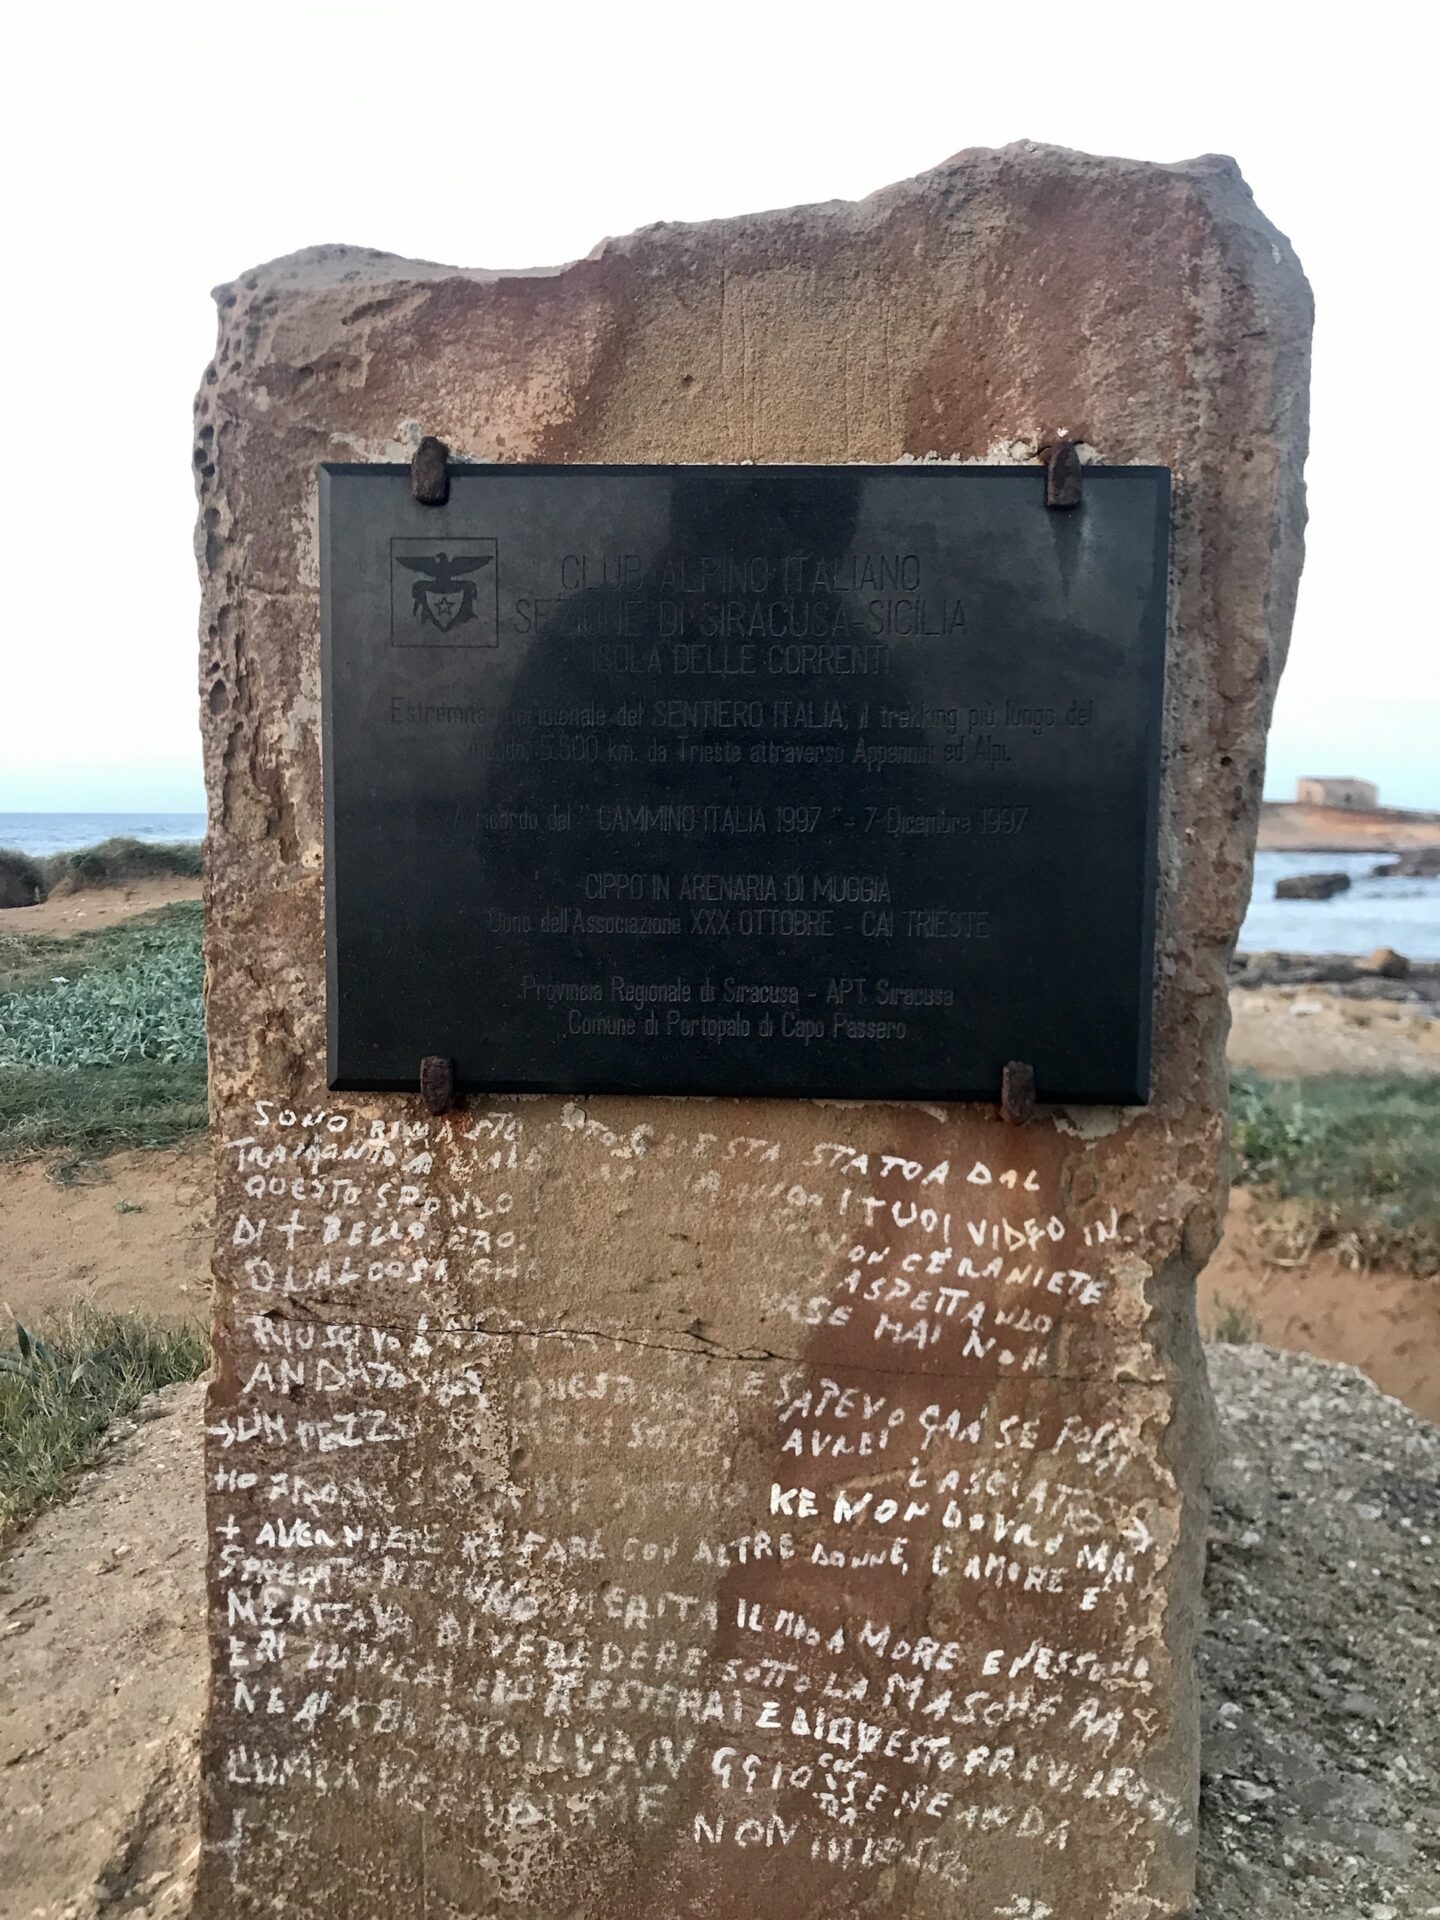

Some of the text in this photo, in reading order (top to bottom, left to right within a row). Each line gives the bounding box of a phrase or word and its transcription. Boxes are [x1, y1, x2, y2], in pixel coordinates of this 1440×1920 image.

[560, 553, 921, 593] CLUB ALPINO ITALIANO
[515, 598, 643, 637] SEZIONE
[660, 600, 685, 638] DI
[591, 643, 892, 675] ISOLA DELLE CORRENTI
[617, 699, 644, 727] del
[652, 700, 763, 729] SENTIERO
[880, 700, 958, 735] trekking
[1005, 700, 1055, 735] lungo
[1065, 699, 1093, 730] del
[648, 736, 667, 762] da
[677, 735, 743, 764] Trieste
[750, 737, 845, 765] attraverso
[852, 736, 936, 773] Appennini
[944, 738, 964, 764] ed
[703, 804, 767, 834] ITALIA
[887, 804, 972, 837] Dicembre
[981, 806, 1030, 836] 1997
[584, 872, 891, 904] CIPPO IN ARENARIA DI MUGGIA
[690, 908, 730, 936] XXX
[739, 908, 835, 937] OTTOBRE
[860, 909, 894, 937] CAI
[901, 910, 991, 939] TRIESTE
[520, 974, 603, 1003] Provincia
[611, 975, 692, 1011] Regionale
[700, 976, 717, 1004] di
[724, 976, 799, 1005] Siracusa
[875, 978, 955, 1007] Siracusa
[568, 1008, 908, 1047] Comune di Portopalo di Capo Passero
[254, 1100, 349, 1132] SONO
[322, 1216, 426, 1247] BELLO
[873, 1313, 942, 1351] MAI
[769, 1483, 819, 1518] KE
[832, 1488, 929, 1525] NON
[692, 1531, 795, 1569] ALTRE
